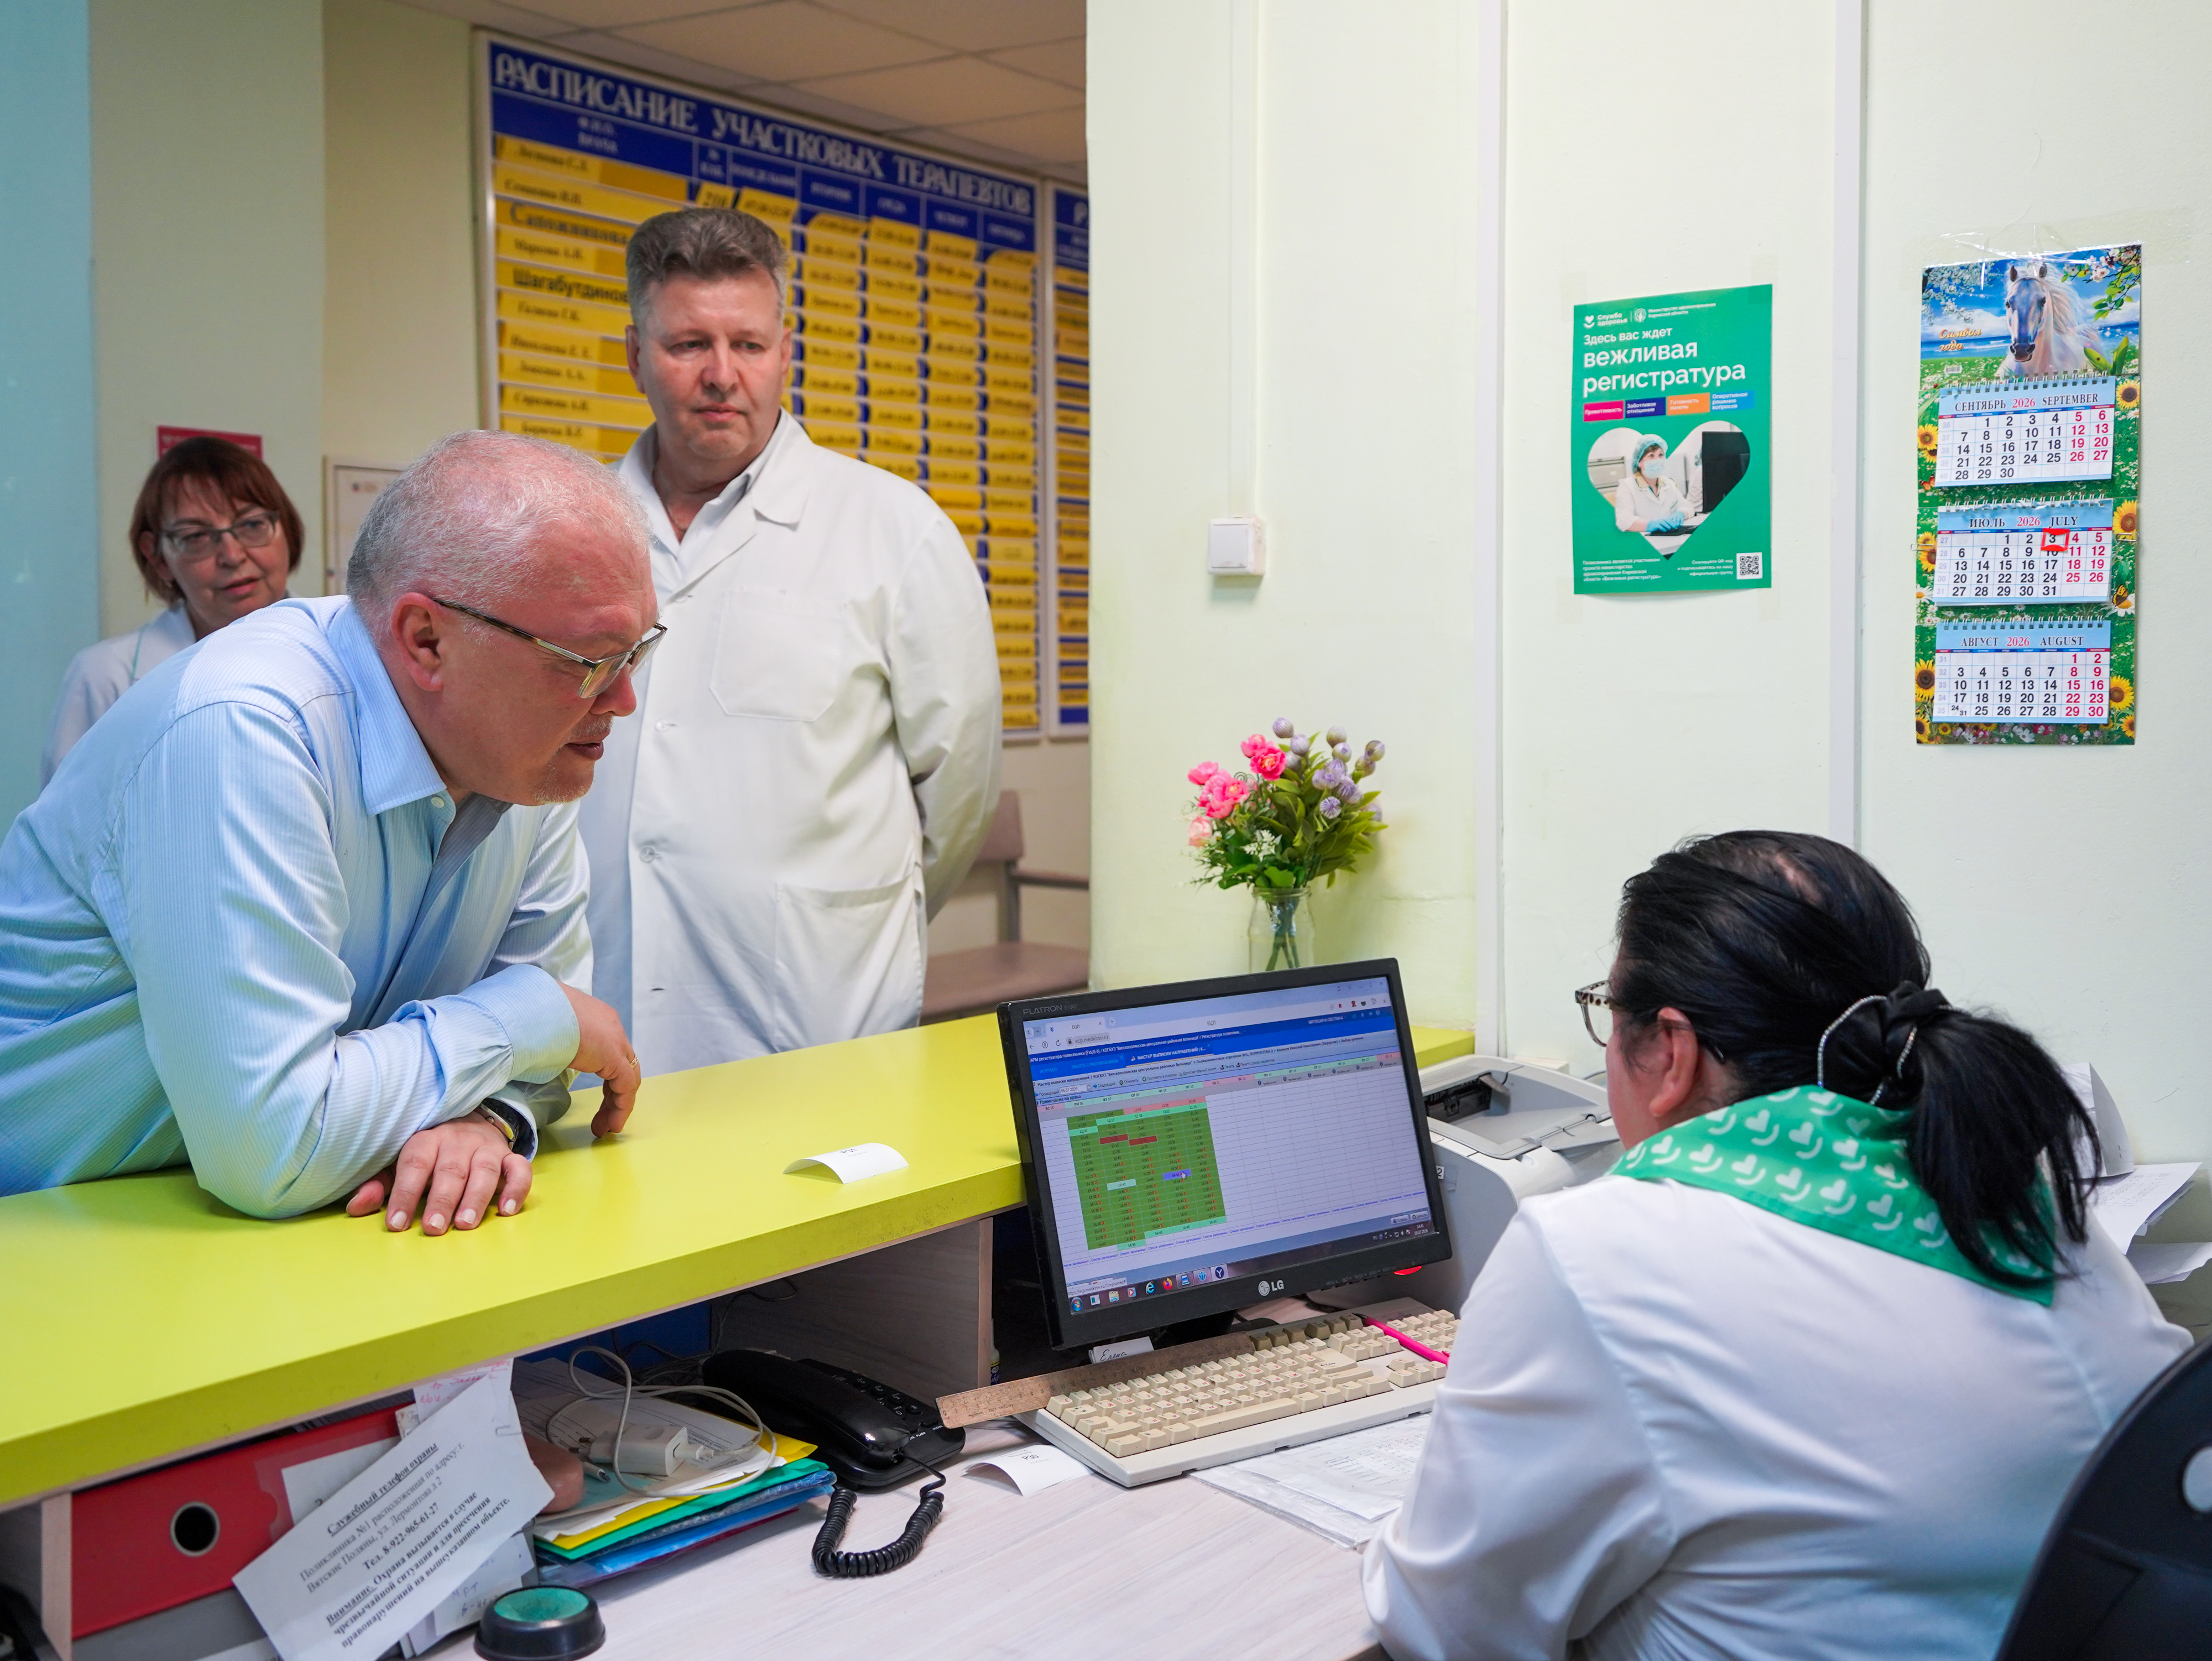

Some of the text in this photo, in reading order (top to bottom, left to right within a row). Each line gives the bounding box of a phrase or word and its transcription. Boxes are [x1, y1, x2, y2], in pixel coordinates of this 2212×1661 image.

[494, 52, 700, 134] РАСПИСАНИЕ
[712, 107, 884, 182] УЧАСТКОВЫХ
[891, 155, 1031, 217] ТЕРАПЕВТОВ
[1597, 317, 1627, 326] здоровья
[1584, 327, 1673, 345] Здесь вас ждет
[1939, 328, 1982, 339] Символ
[1940, 339, 1963, 352] года
[1584, 342, 1698, 368] вежливая
[1583, 363, 1746, 398] регистратура
[1955, 393, 2099, 412] СЕНТЯБРЬ 2026 SEPTEMBER
[1986, 410, 2105, 427] 1 2 3 4 5 6
[1961, 424, 2108, 441] 7 8 9 10 11 12 13
[1958, 437, 2108, 454] 14 15 16 17 18 19 20
[1958, 450, 2107, 467] 21 22 23 24 25 26 27
[1955, 468, 2013, 480] 28 29 30
[1970, 516, 2078, 528] ИЮЛЬ 2026 JULY
[1961, 636, 2084, 647] АВГУСТ 2026 AUGUST
[1023, 1005, 1062, 1015] FLATRON
[1075, 1035, 1109, 1044] ecp.medkirov.ru
[1271, 1279, 1284, 1292] LG
[327, 1443, 438, 1538] Служебный телефон охраны
[300, 1534, 356, 1581] Поликлиника
[356, 1521, 371, 1537] №1
[372, 1477, 425, 1526] расположенная
[425, 1468, 435, 1479] по
[435, 1447, 459, 1471] адресу:
[306, 1563, 342, 1593] Вятские
[342, 1537, 378, 1565] Поляны,
[377, 1525, 390, 1539] ул.
[390, 1488, 432, 1525] Лермонтова
[436, 1476, 442, 1486] 2
[362, 1502, 438, 1570] Тел. 8-922-965-61-27
[326, 1586, 376, 1626] Внимание.
[373, 1557, 406, 1584] Охрана
[406, 1518, 449, 1559] вызывается
[453, 1492, 477, 1516] случае
[334, 1582, 396, 1634] чрезвычайной
[397, 1551, 432, 1584] ситуации
[440, 1532, 452, 1548] для
[452, 1497, 491, 1534] пресечения
[342, 1584, 414, 1648] правонарушений
[414, 1575, 425, 1586] на
[425, 1523, 481, 1576] вышеуказанном
[481, 1499, 510, 1524] объекте.
